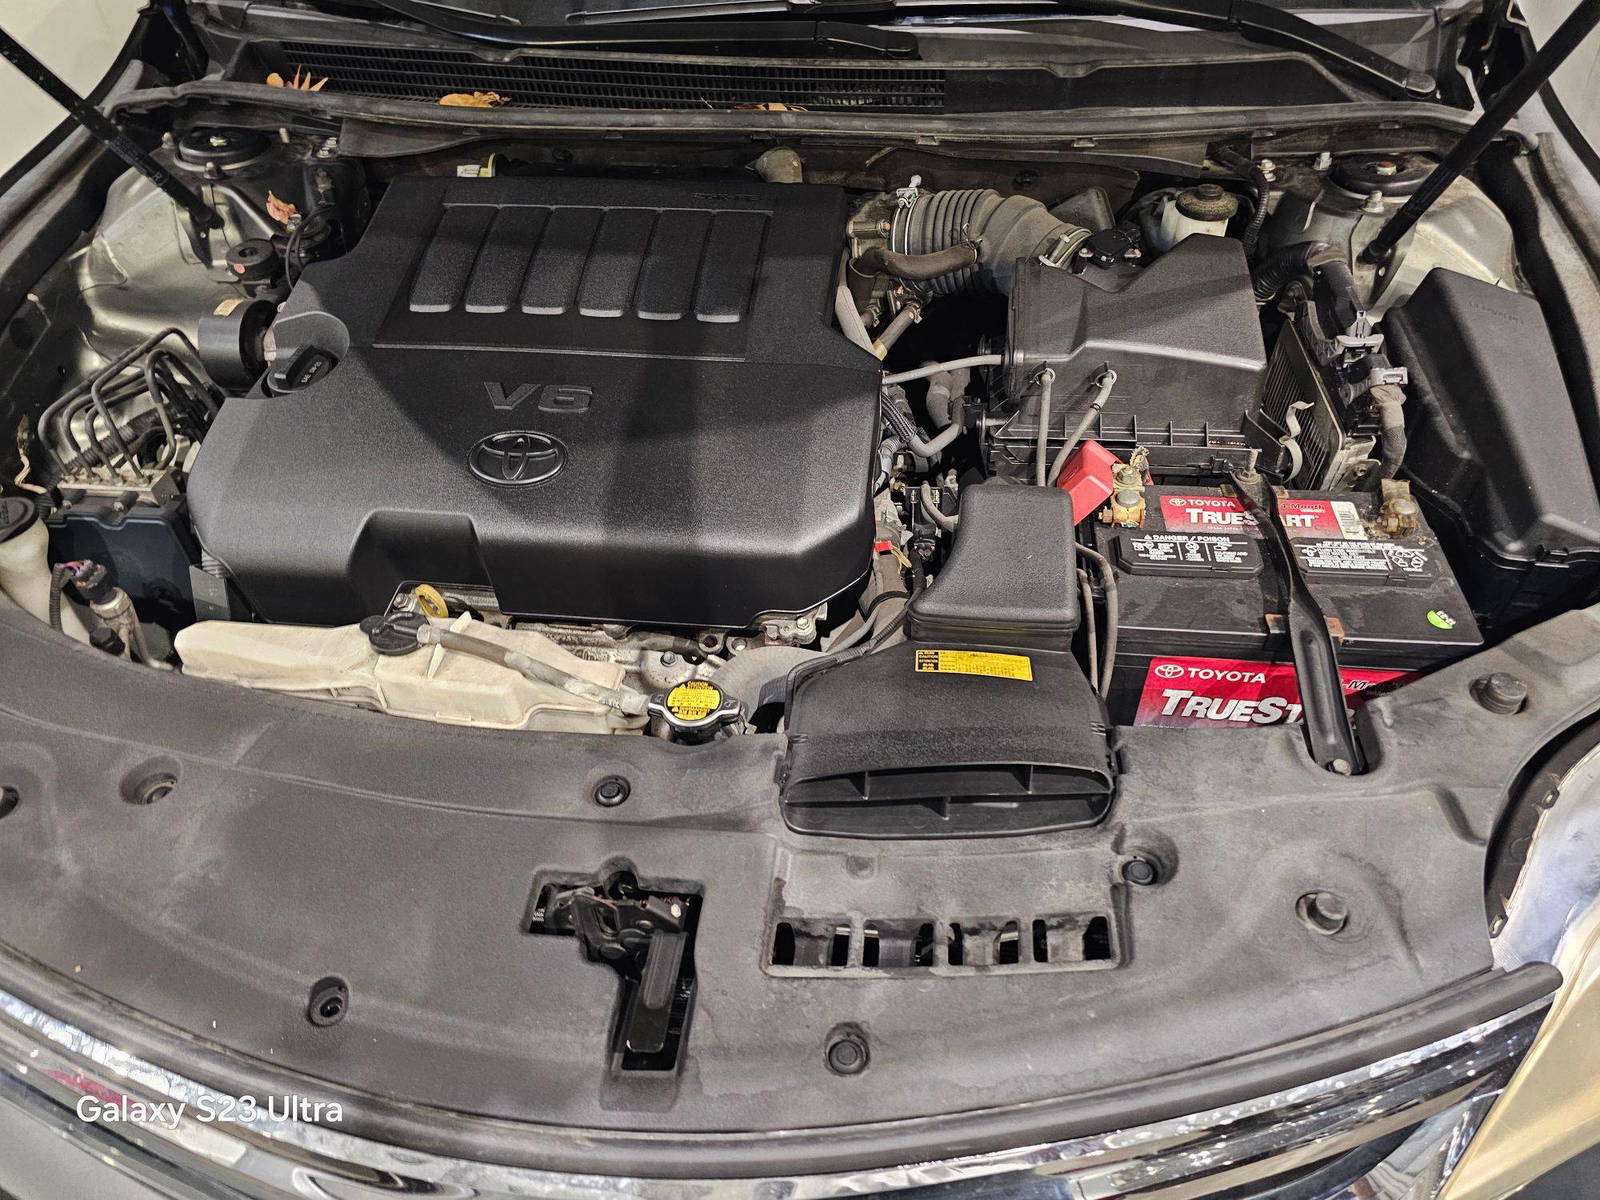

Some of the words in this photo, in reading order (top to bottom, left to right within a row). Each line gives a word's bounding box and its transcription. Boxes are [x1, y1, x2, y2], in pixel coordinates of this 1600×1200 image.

[483, 382, 592, 413] V6
[1187, 499, 1236, 508] TOYOTA
[1188, 667, 1266, 684] TOYOTA
